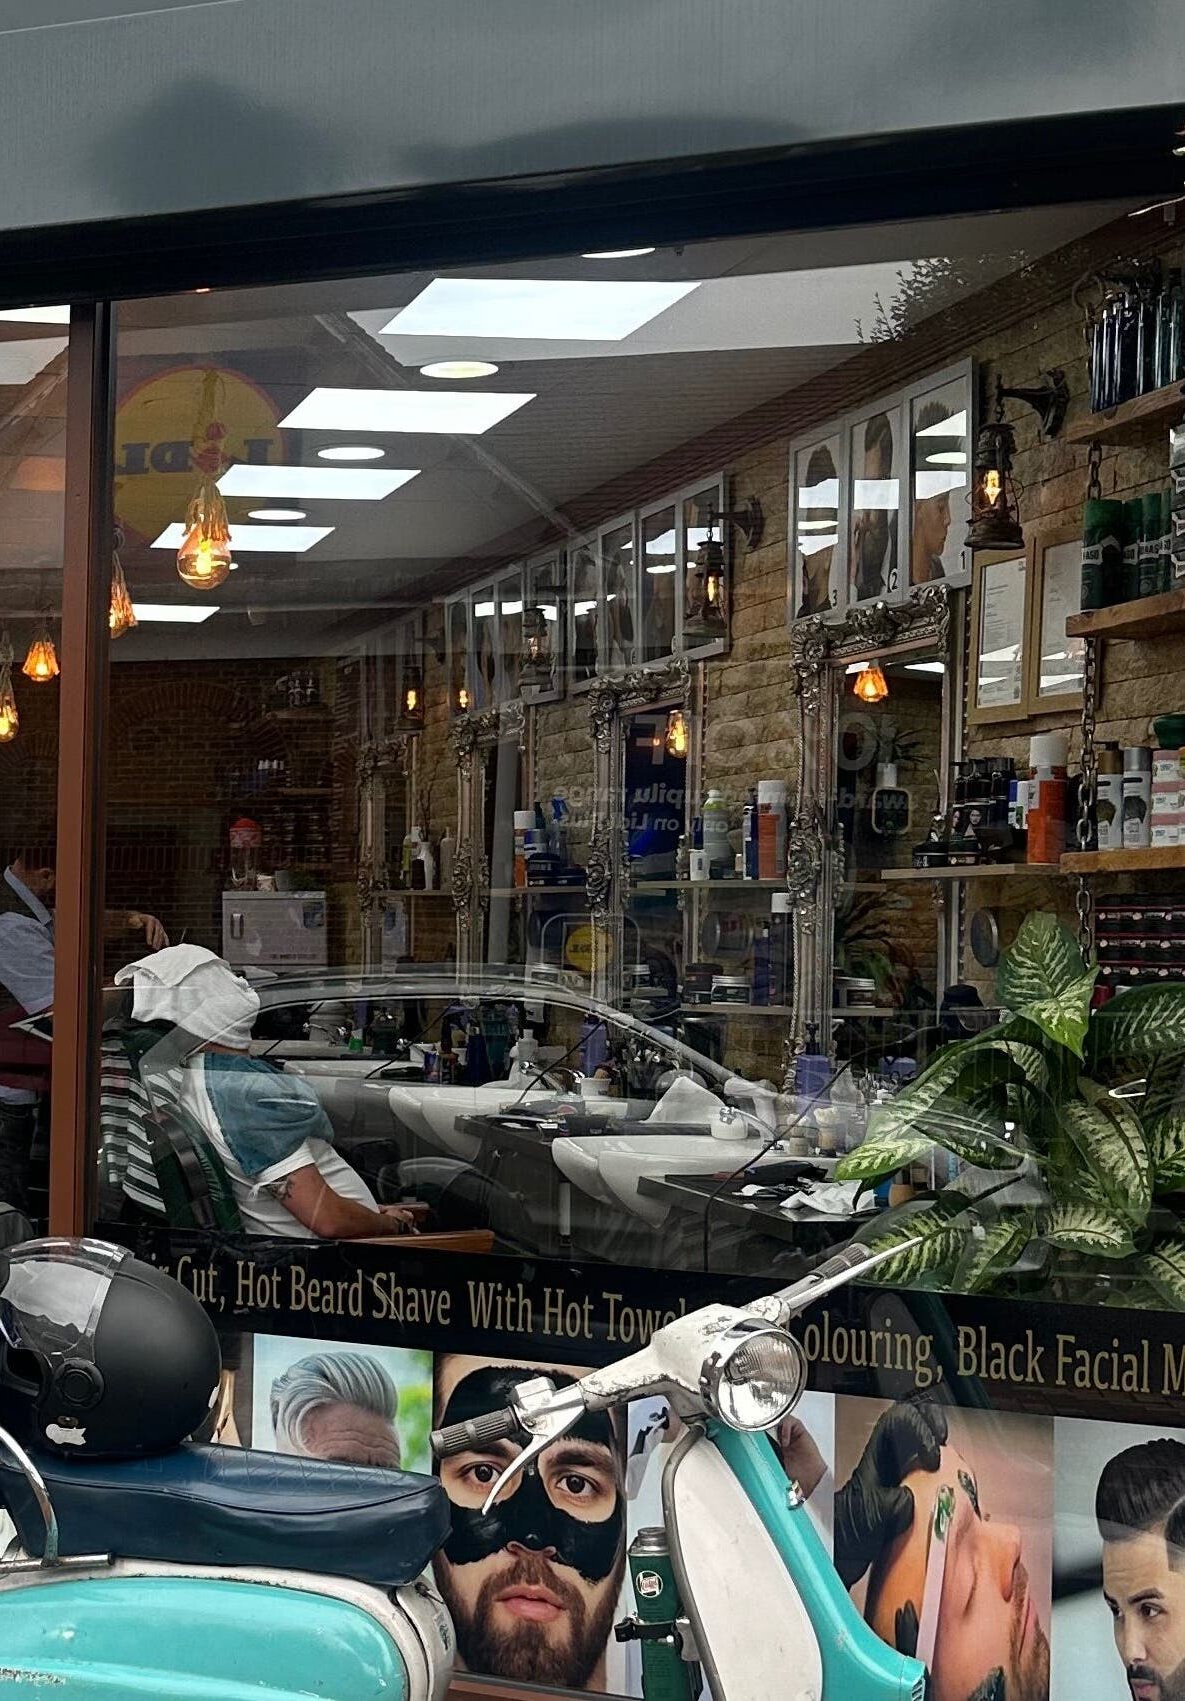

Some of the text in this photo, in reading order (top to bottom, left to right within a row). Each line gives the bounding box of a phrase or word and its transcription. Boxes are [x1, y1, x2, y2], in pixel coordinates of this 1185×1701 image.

[236, 1260, 282, 1308] Hot
[289, 1264, 363, 1318] Beard
[372, 1271, 451, 1326] Shave
[466, 1279, 534, 1333] With
[543, 1287, 593, 1339] Hot
[796, 1308, 943, 1389] olouring,
[957, 1325, 1045, 1384] Black
[1055, 1334, 1151, 1394] Facial
